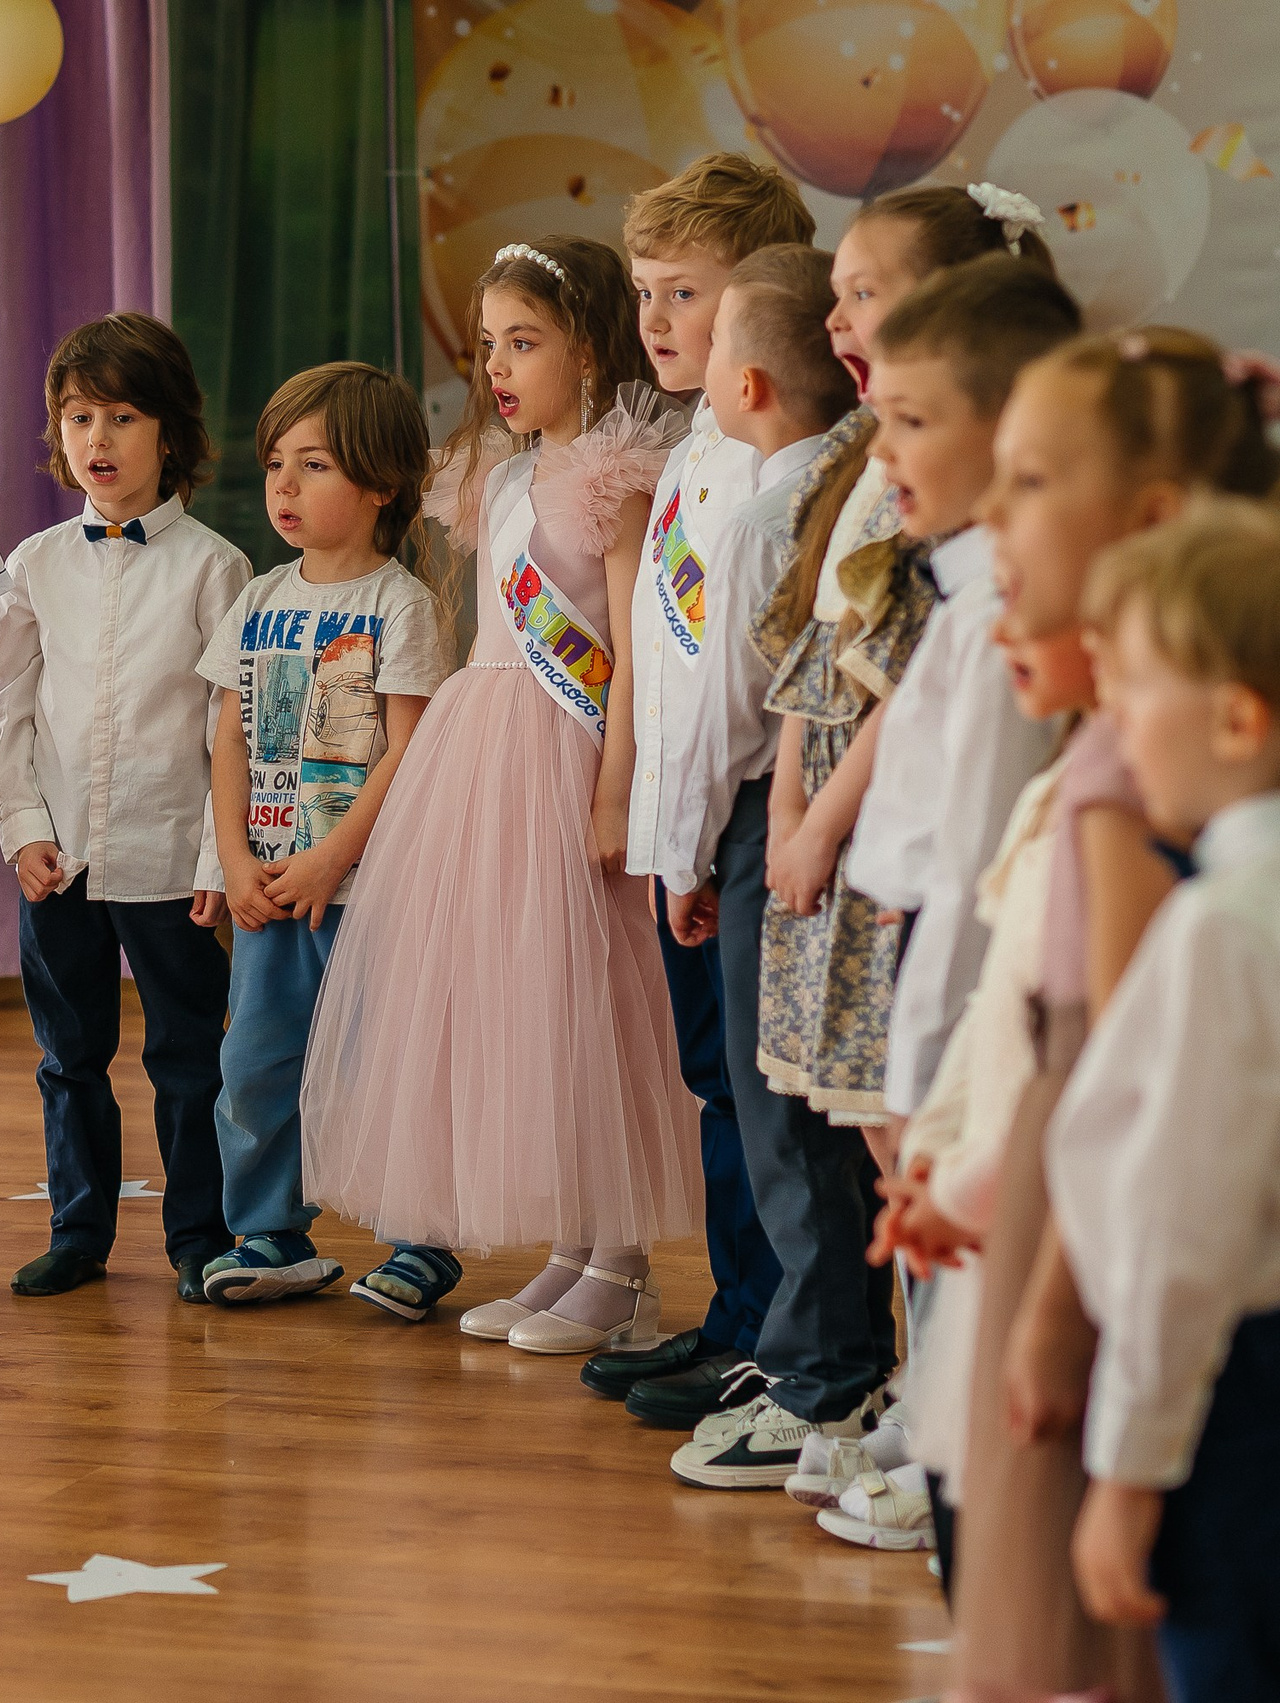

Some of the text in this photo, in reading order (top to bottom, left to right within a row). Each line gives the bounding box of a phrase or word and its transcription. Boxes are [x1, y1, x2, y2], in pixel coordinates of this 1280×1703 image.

[240, 609, 312, 651] MAKE
[656, 570, 700, 656] детского
[515, 563, 613, 711] ВЫПУ
[525, 638, 601, 717] детского
[254, 792, 295, 803] FAVORITE
[273, 771, 298, 790] ON
[249, 805, 294, 827] USIC
